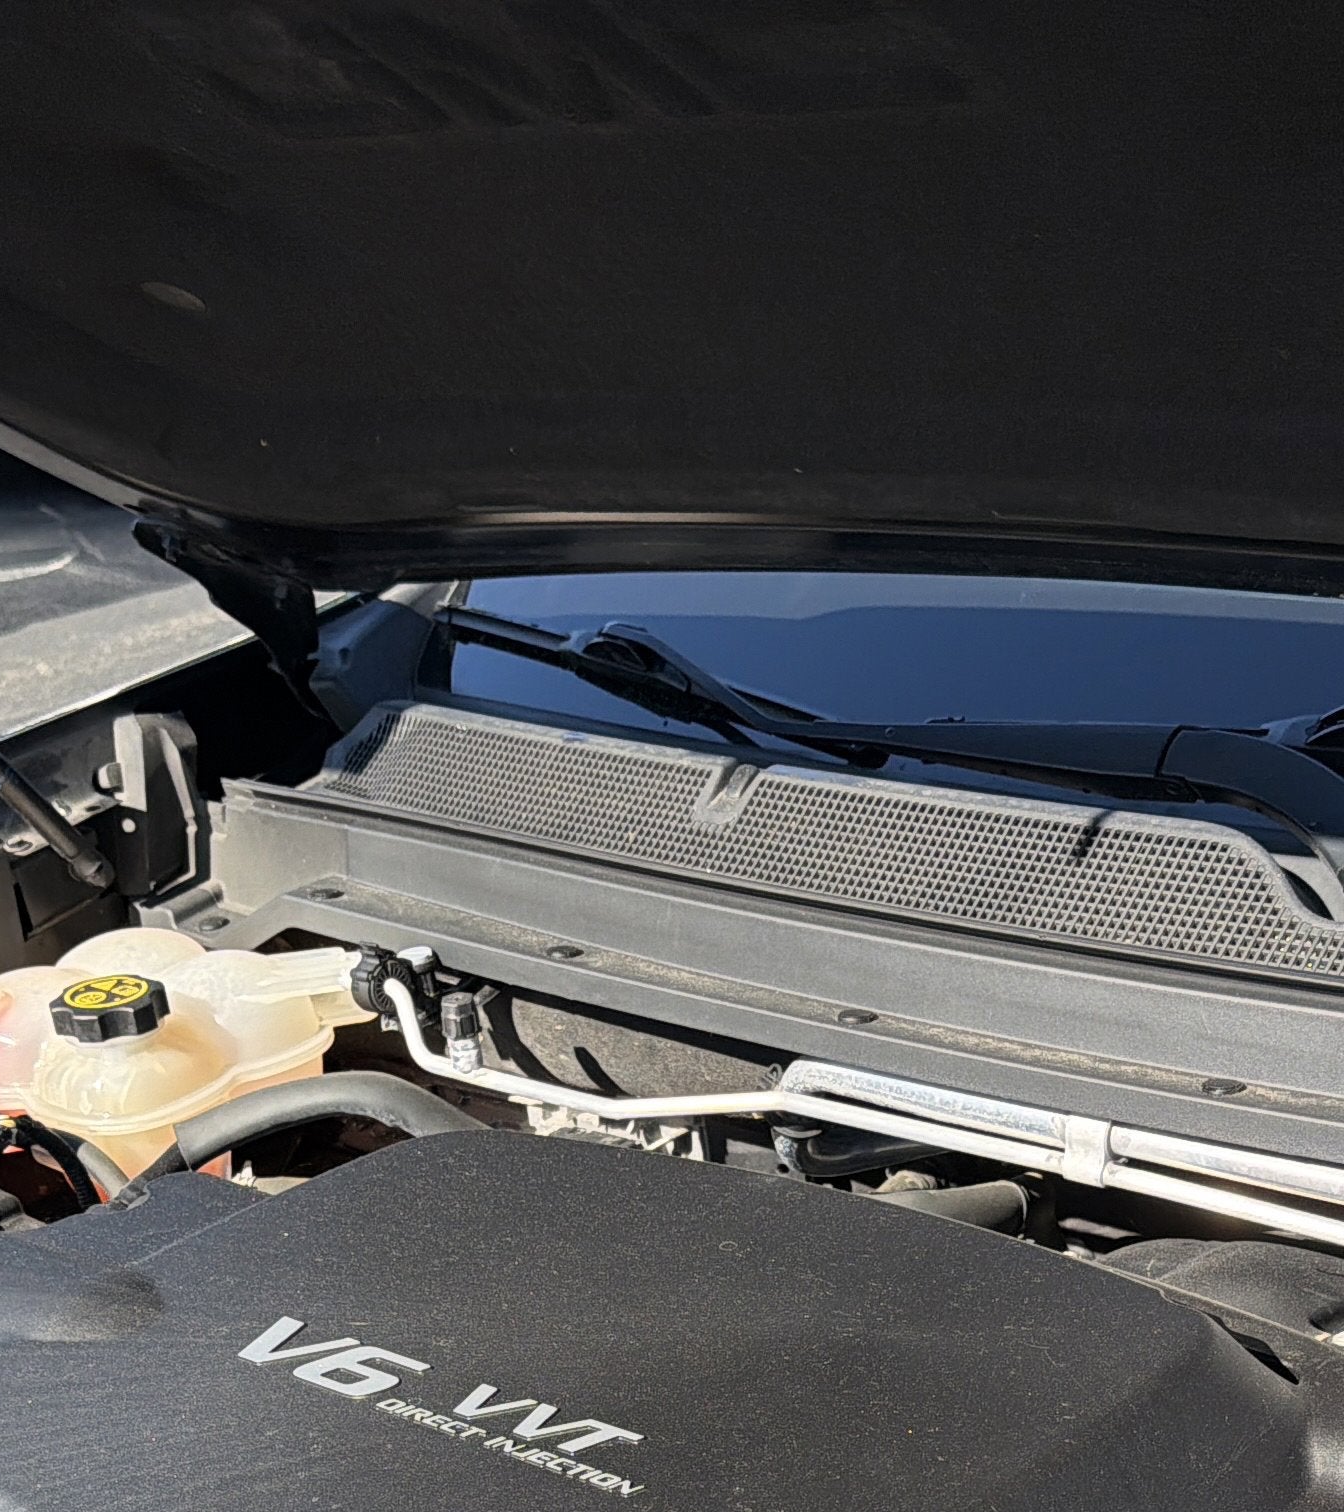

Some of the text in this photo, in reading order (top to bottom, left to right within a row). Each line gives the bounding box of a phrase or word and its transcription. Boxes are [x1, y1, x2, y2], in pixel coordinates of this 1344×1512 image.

[238, 1315, 645, 1456] V6 VVT
[375, 1398, 645, 1497] DIRECT INJECTION
